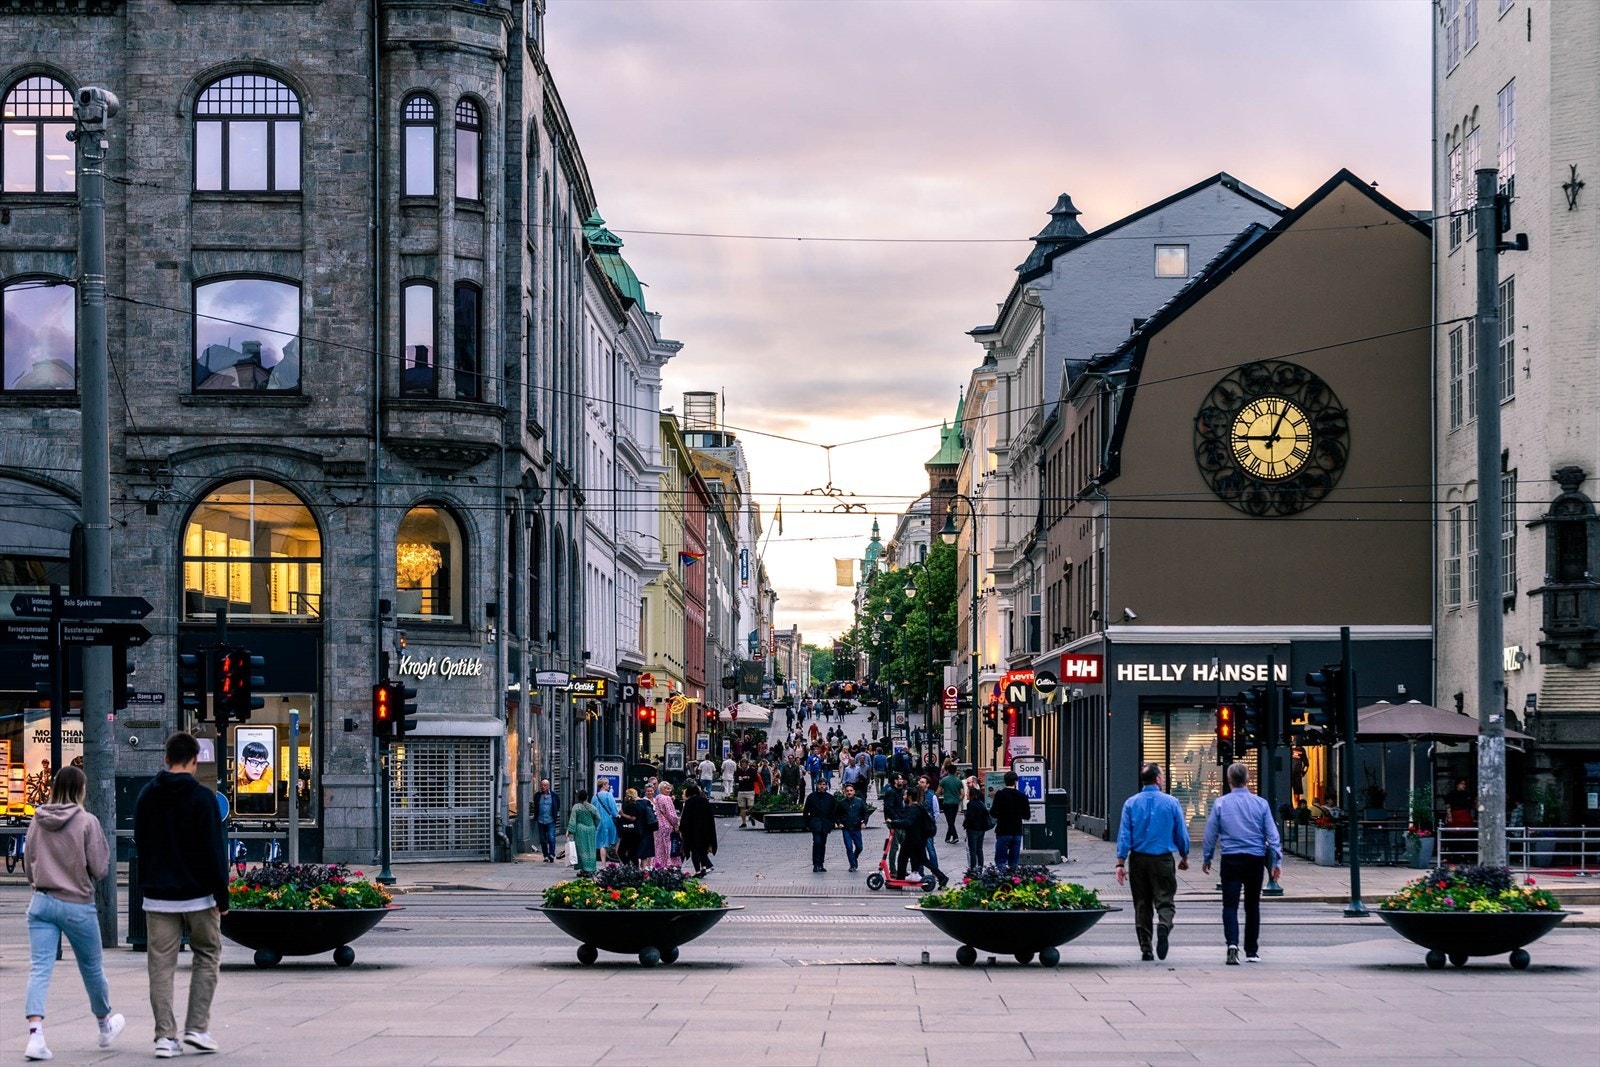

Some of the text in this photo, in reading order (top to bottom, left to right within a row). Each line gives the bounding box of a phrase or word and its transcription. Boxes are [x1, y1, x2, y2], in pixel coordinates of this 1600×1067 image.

[76, 600, 102, 608] Spektrum
[399, 655, 482, 680] Krogh Optikk
[1066, 660, 1098, 677] HH
[1117, 664, 1288, 681] HELLY HANSEN
[573, 682, 594, 692] Optikk
[1010, 685, 1027, 703] N
[599, 763, 619, 772] Sone
[1019, 764, 1040, 772] Sone
